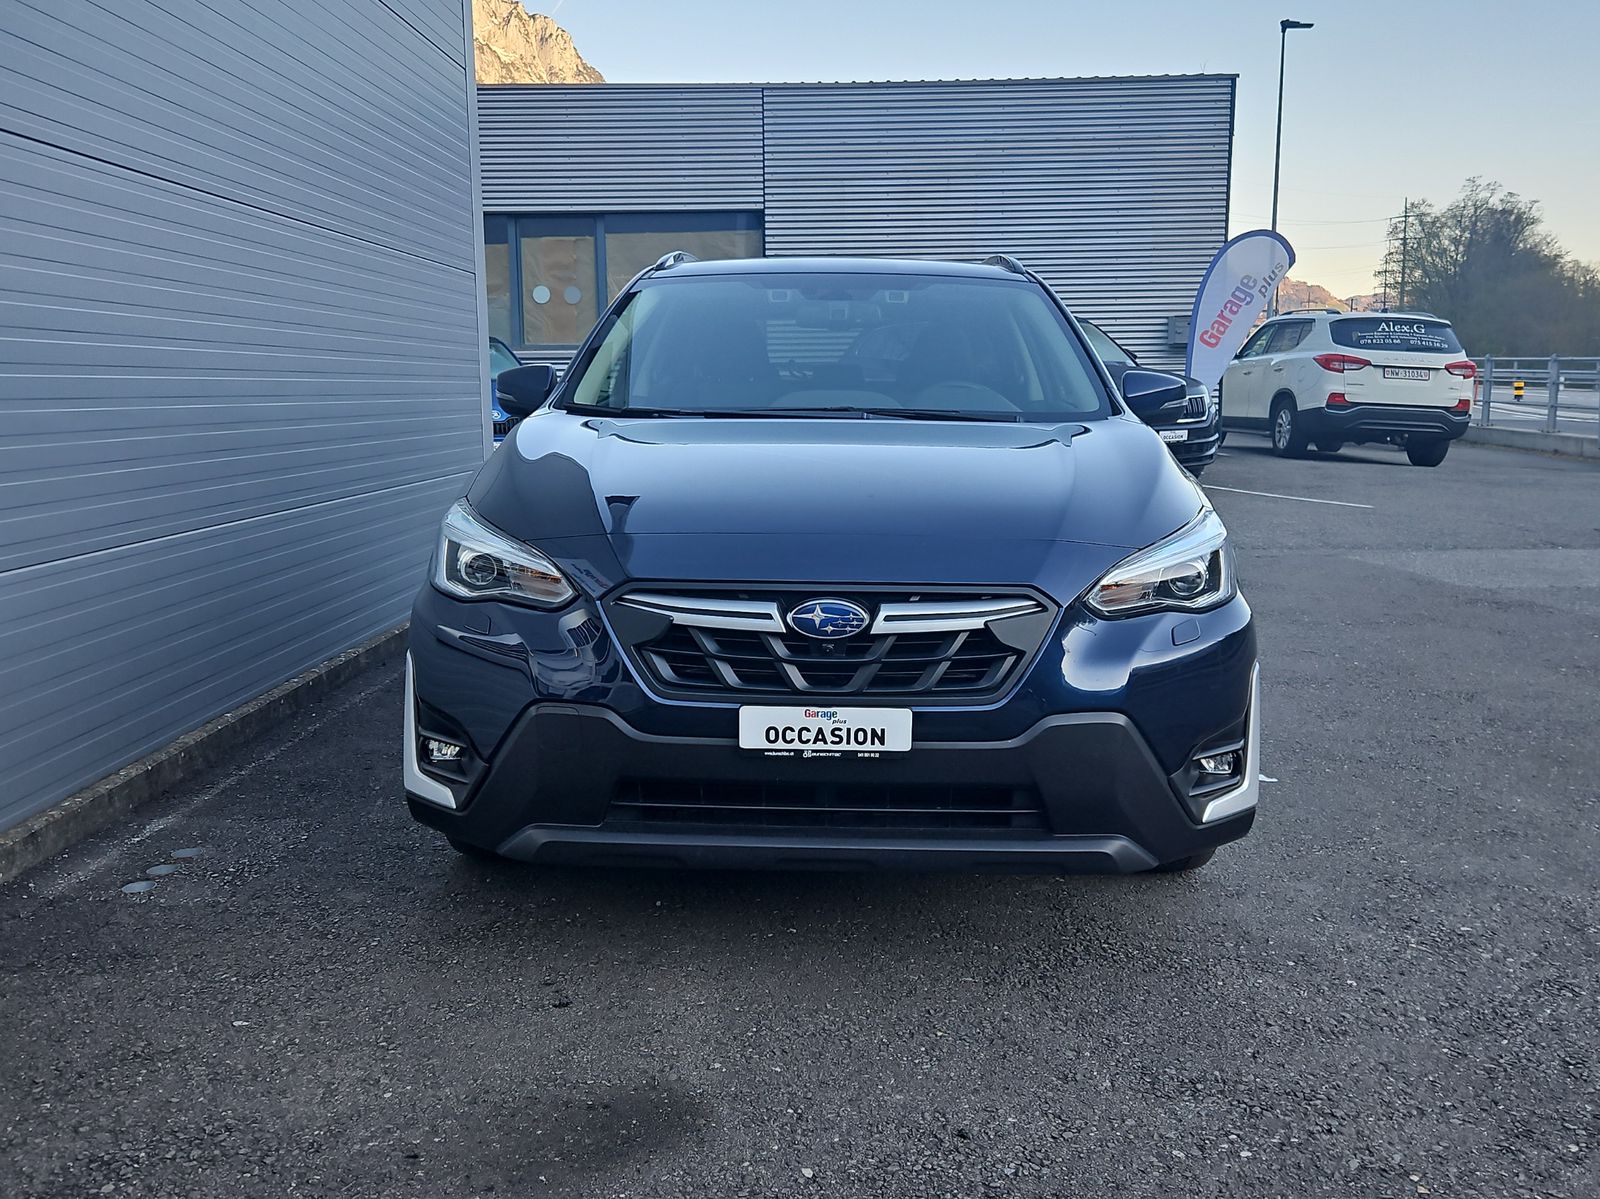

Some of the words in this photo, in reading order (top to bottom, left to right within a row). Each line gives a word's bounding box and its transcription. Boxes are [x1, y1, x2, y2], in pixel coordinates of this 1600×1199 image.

[1258, 262, 1284, 298] plus
[1200, 274, 1257, 348] Garage
[1377, 321, 1425, 334] Alex.G
[804, 708, 838, 720] Garage
[764, 725, 886, 747] OCCASION
